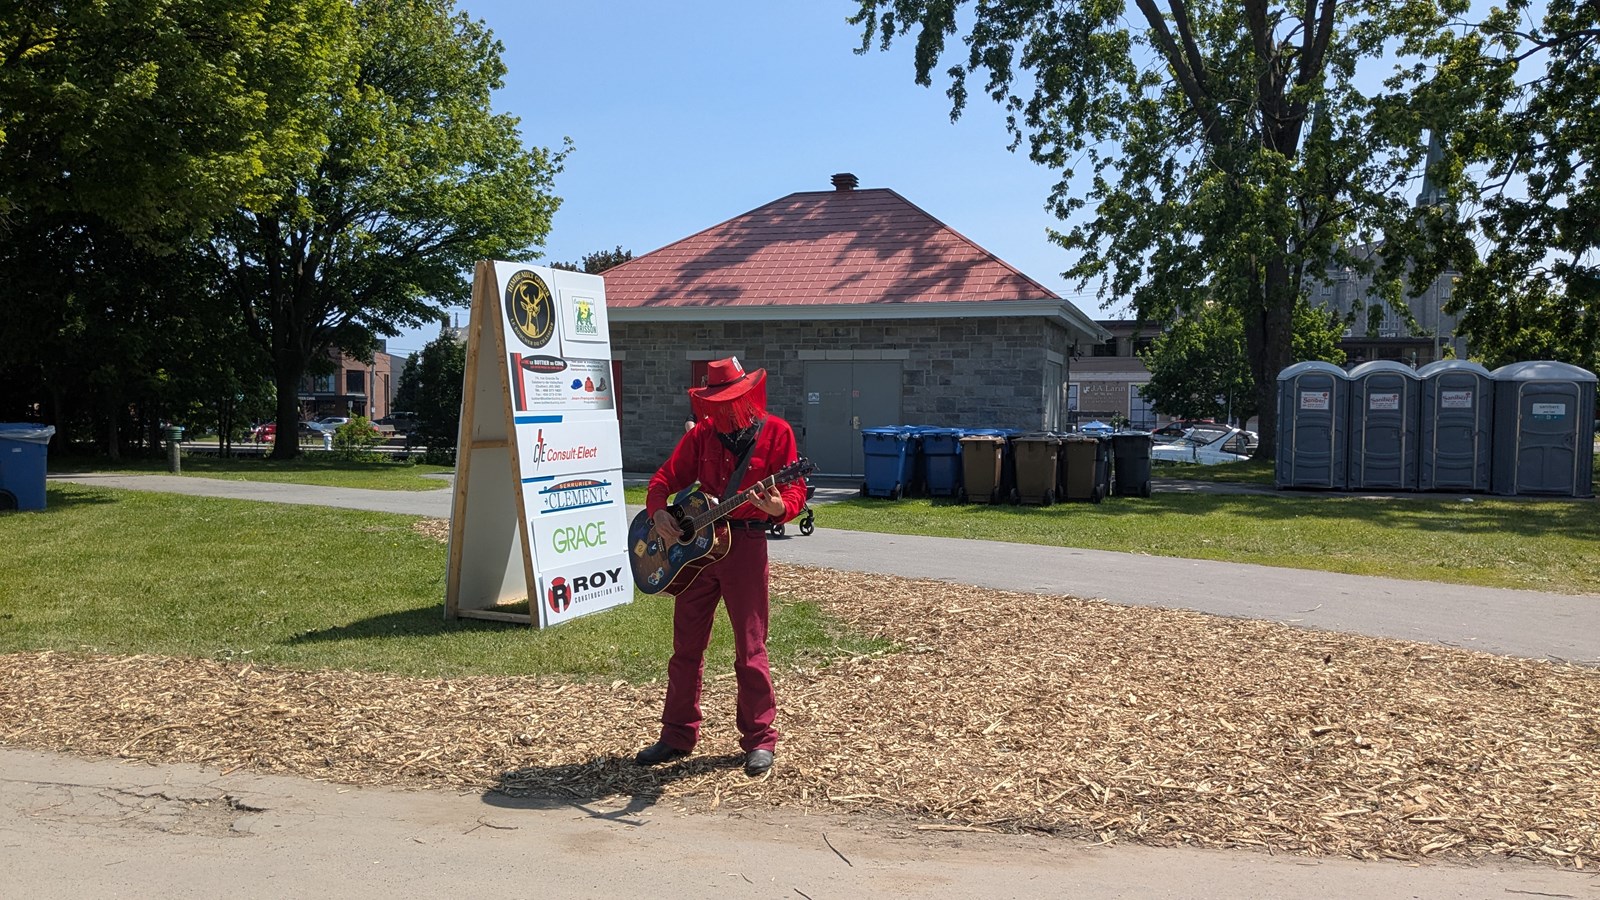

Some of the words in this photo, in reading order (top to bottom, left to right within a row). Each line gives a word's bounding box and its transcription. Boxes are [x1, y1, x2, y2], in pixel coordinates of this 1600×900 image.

[576, 324, 597, 334] BRISSON
[546, 446, 597, 462] Consult-Elect
[559, 481, 592, 490] SERRURIER
[548, 487, 605, 509] CLEMENT
[552, 521, 607, 554] GRACE
[572, 567, 622, 594] ROY
[574, 588, 613, 604] CONSTRUCTION
